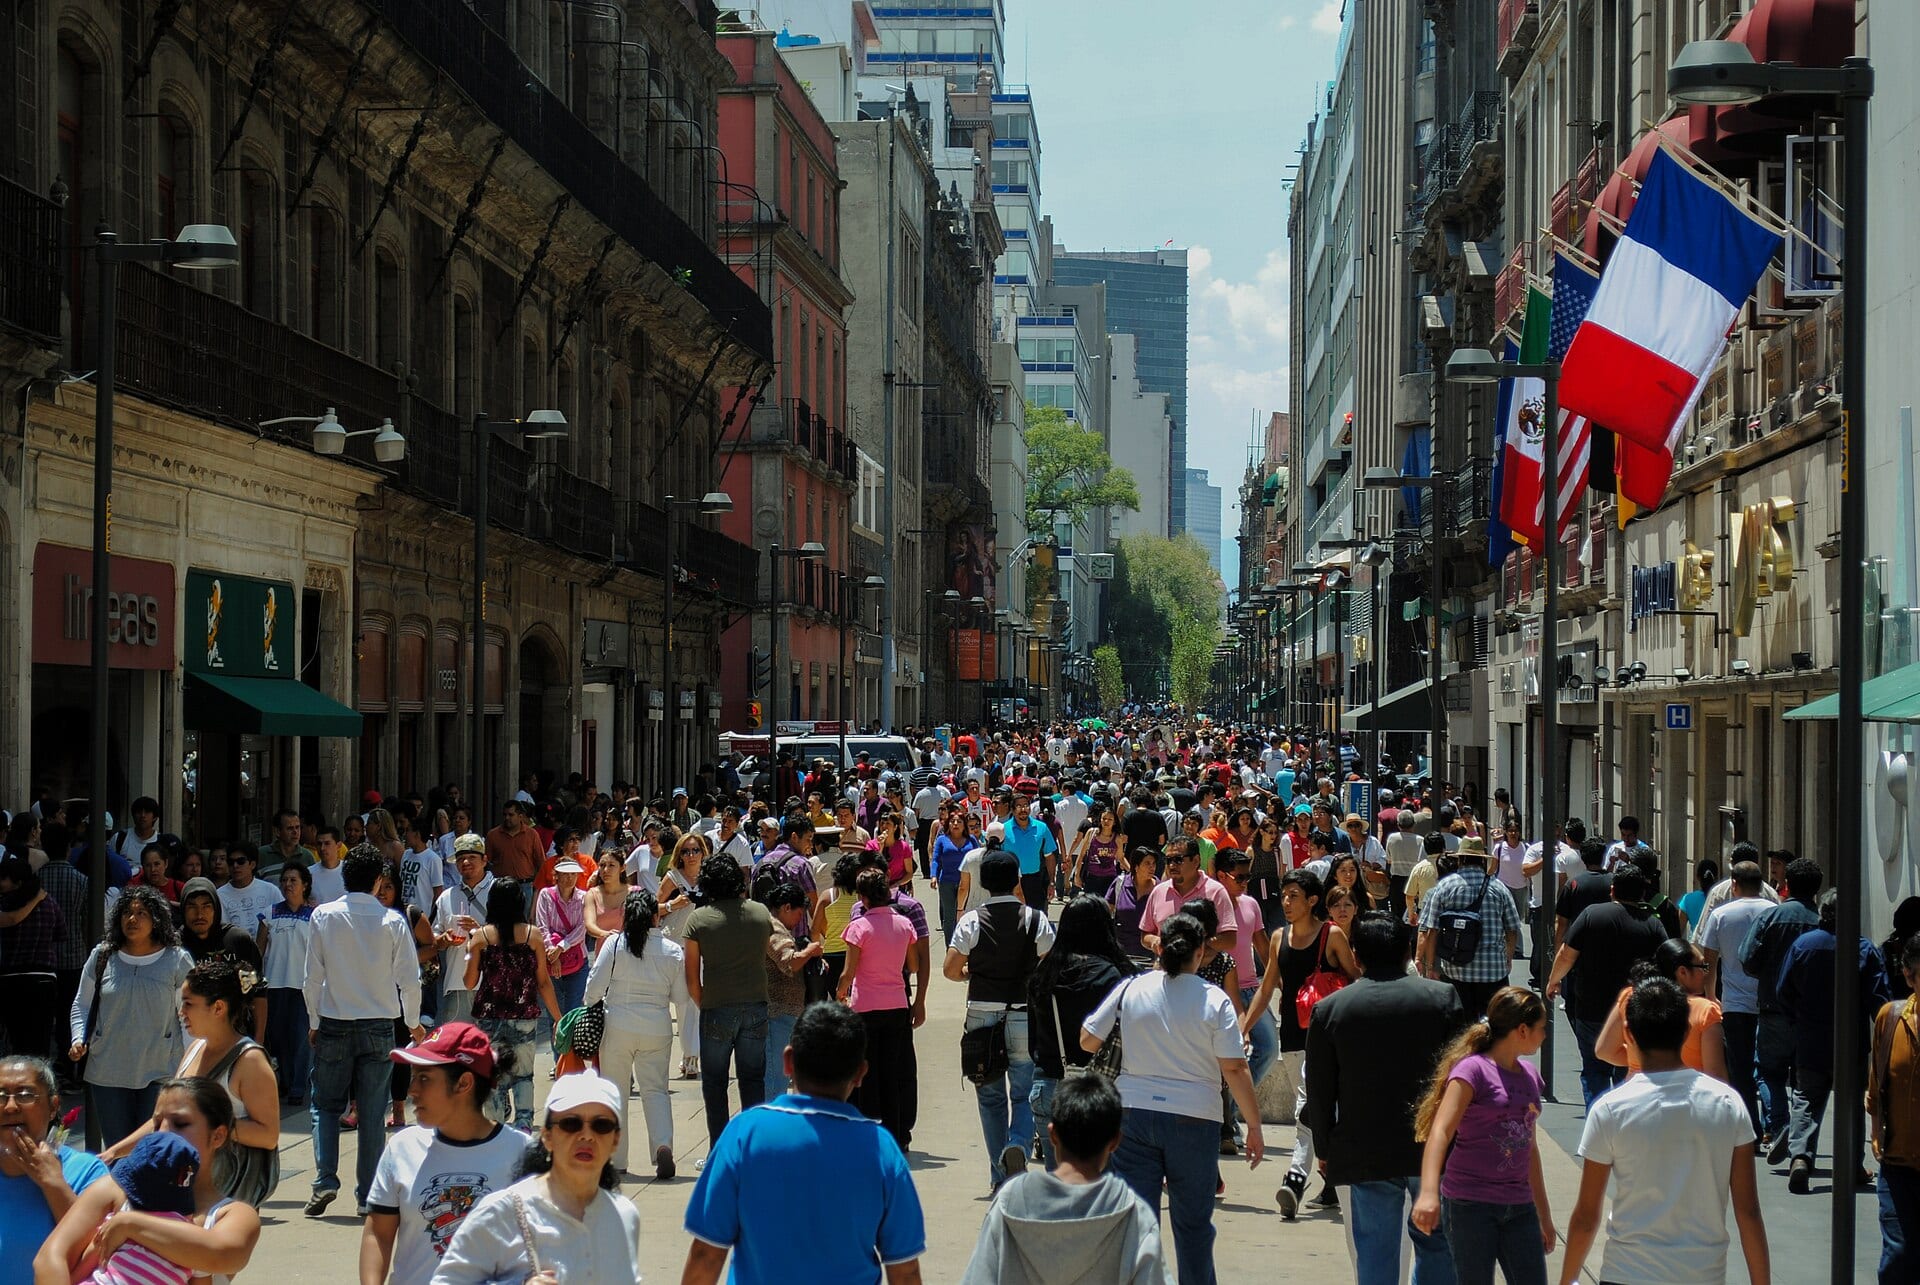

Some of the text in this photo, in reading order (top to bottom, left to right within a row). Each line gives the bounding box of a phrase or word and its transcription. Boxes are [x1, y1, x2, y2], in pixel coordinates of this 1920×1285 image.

[1671, 707, 1686, 726] H
[1055, 746, 1060, 756] 8
[402, 860, 420, 874] SUD
[401, 872, 418, 887] DEN
[403, 887, 416, 899] EA
